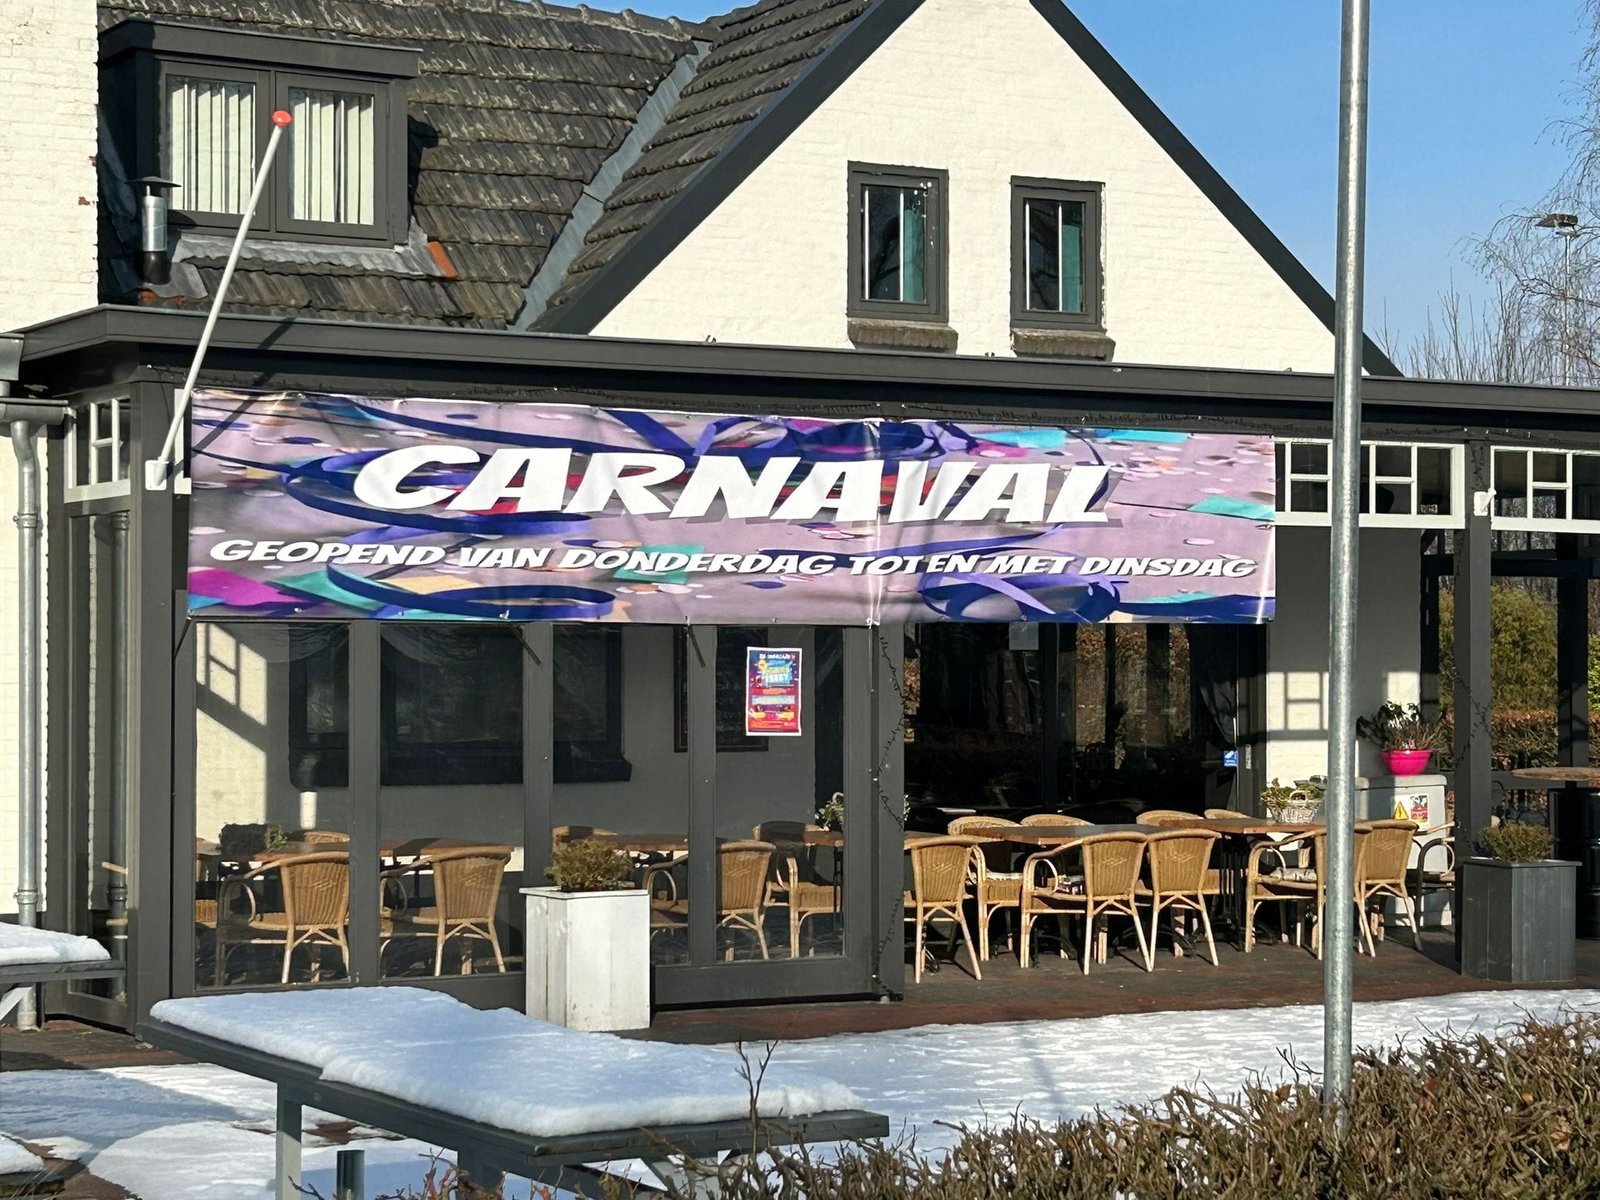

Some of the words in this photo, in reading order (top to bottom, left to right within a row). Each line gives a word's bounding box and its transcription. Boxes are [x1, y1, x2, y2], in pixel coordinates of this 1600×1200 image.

[354, 445, 1111, 523] CARNAVAL
[209, 540, 447, 567] GEOPEND
[458, 546, 548, 569] VAN
[559, 550, 834, 575] DONDERDAG
[849, 554, 924, 575] TOT
[926, 554, 980, 573] EN
[983, 555, 1075, 575] MET
[1080, 557, 1257, 578] DINSDAG
